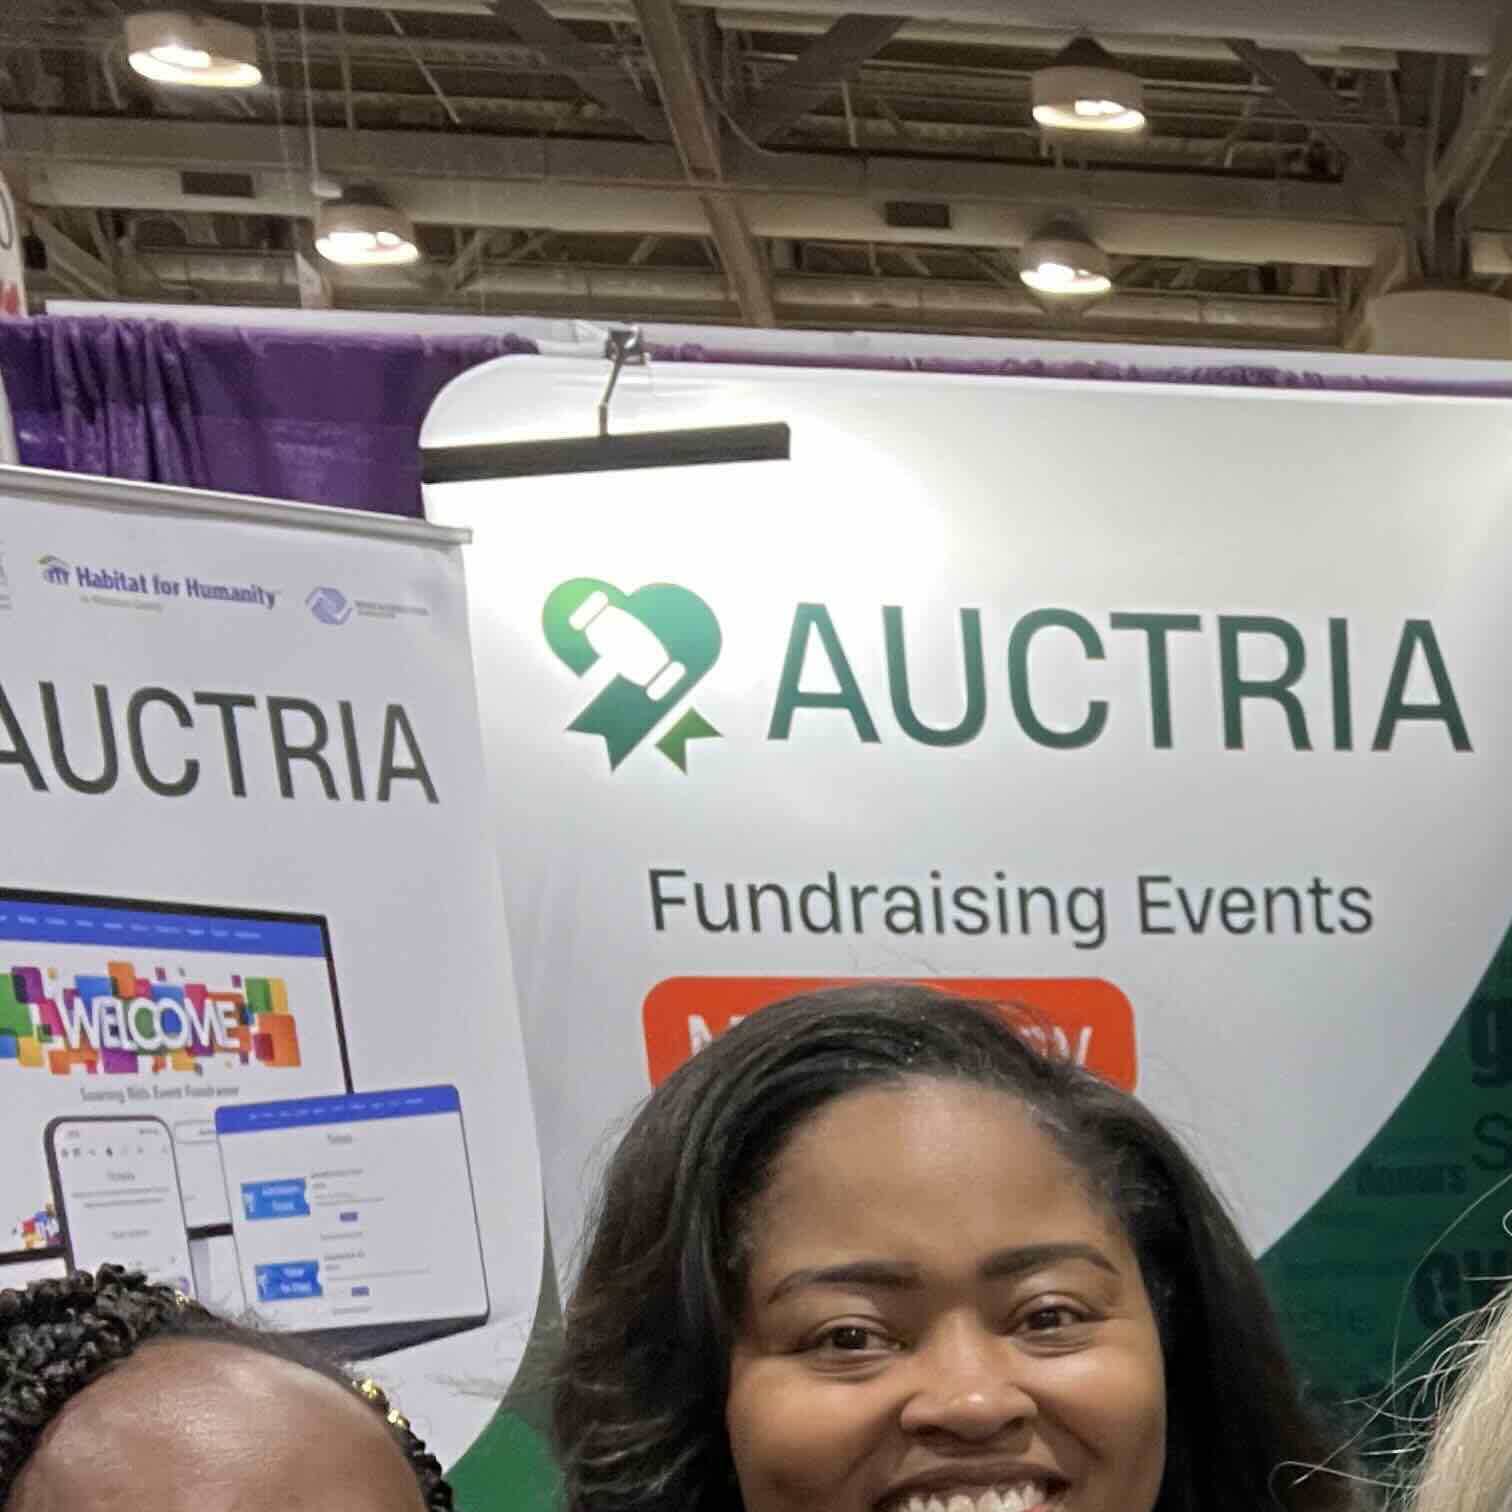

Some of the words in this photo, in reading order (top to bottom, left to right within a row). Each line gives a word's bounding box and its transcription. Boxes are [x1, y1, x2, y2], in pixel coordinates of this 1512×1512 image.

[76, 566, 149, 594] Habitat
[153, 574, 181, 597] for
[185, 576, 276, 611] Humanity
[767, 602, 1474, 752] AUCTRIA
[648, 868, 1107, 950] Fundraising
[1136, 874, 1375, 937] Events
[56, 994, 241, 1051] WELCOME
